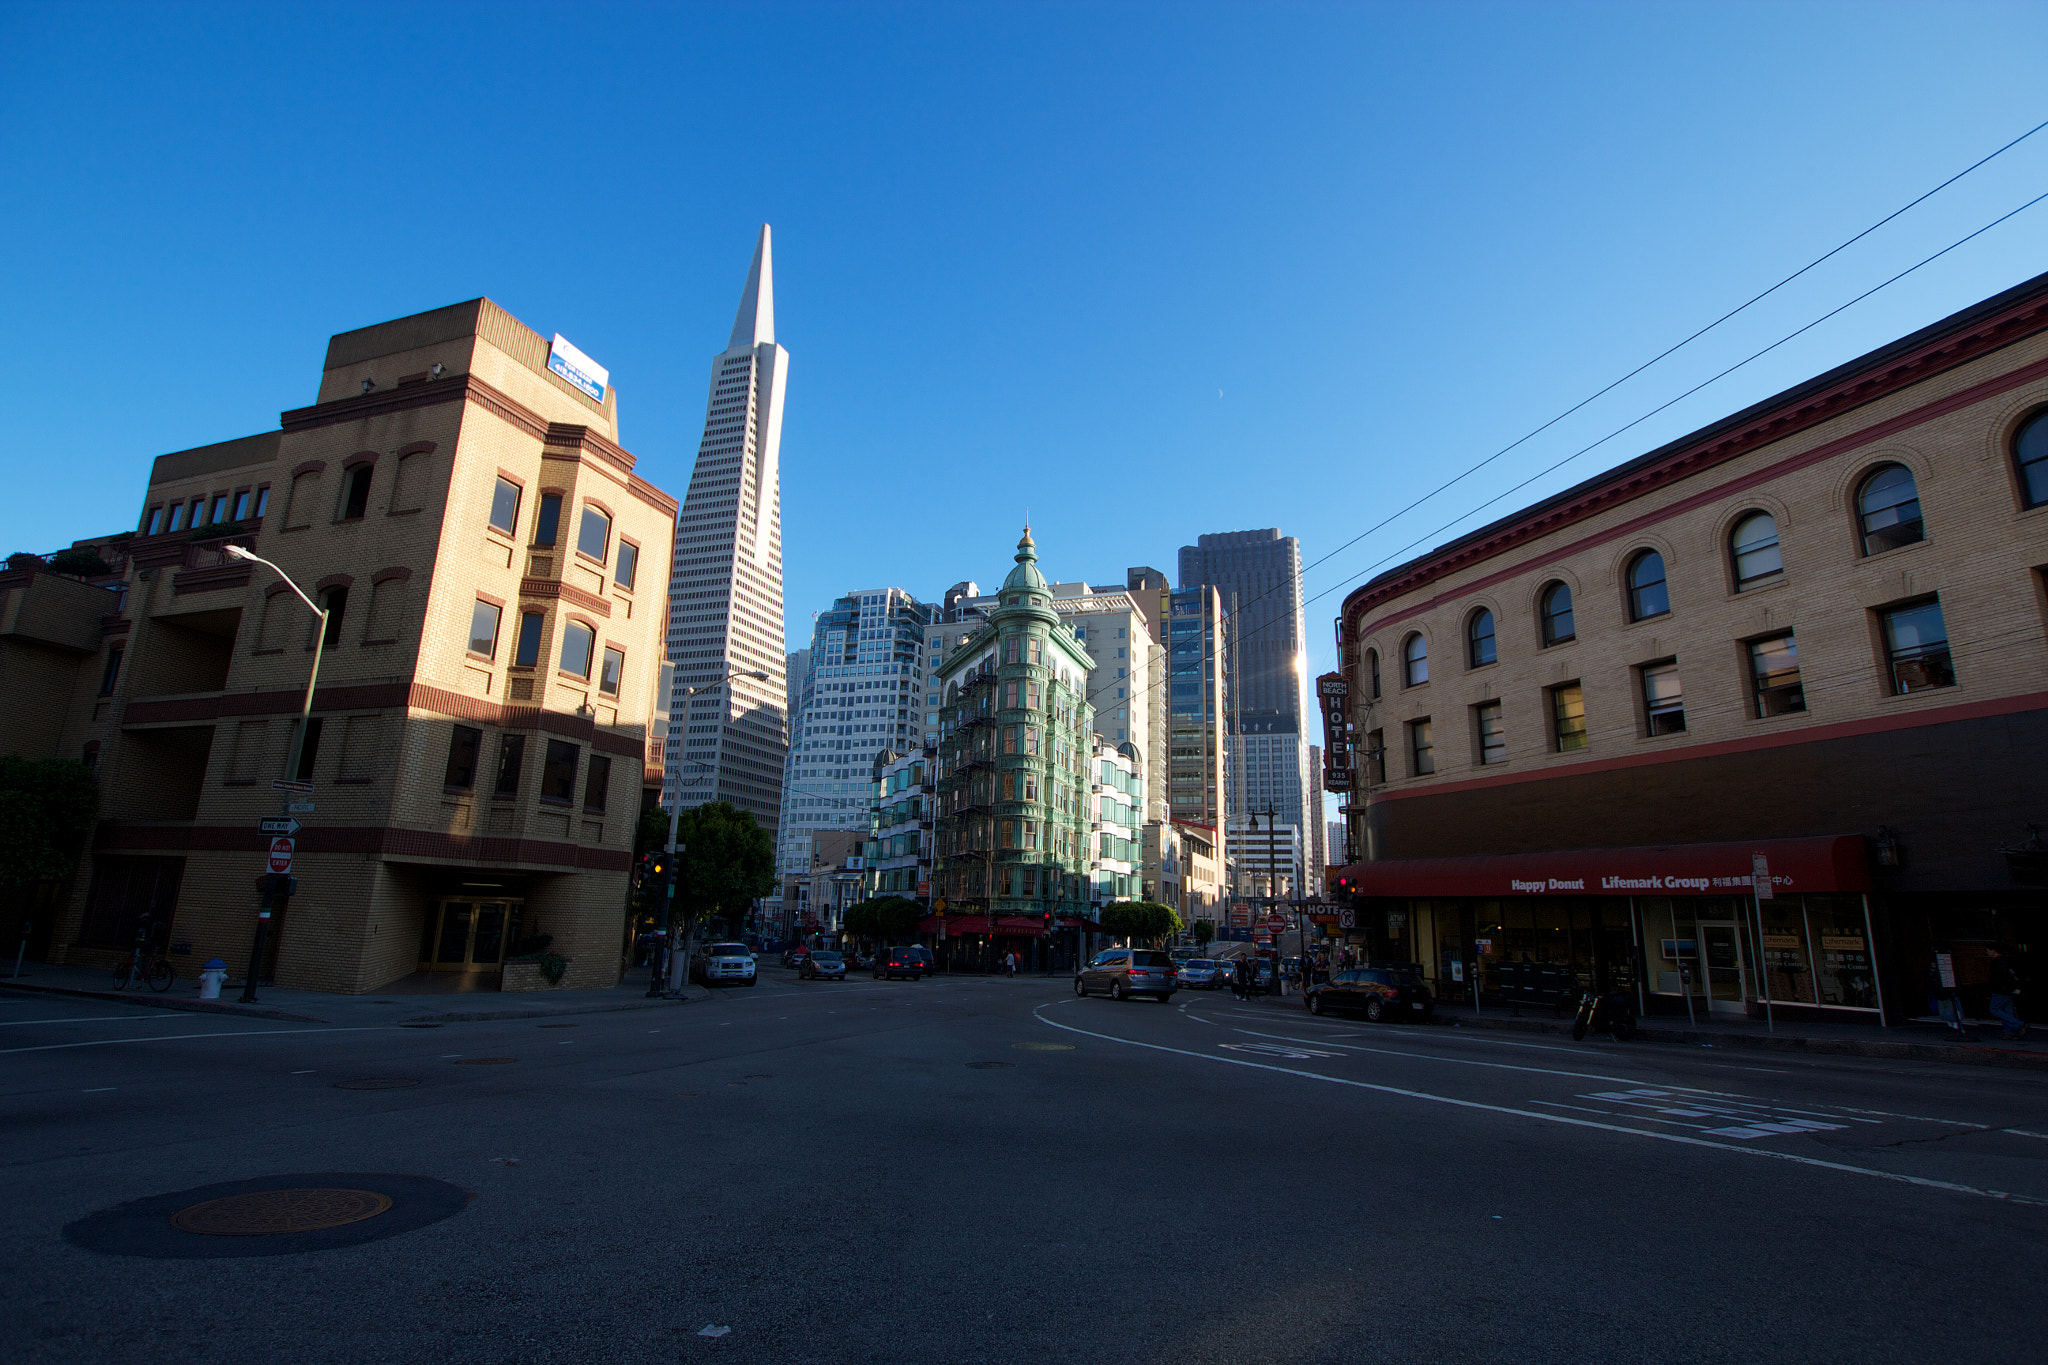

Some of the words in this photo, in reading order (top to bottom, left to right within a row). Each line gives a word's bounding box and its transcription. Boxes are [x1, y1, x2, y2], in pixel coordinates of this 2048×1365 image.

[1323, 681, 1347, 689] NORTH
[1330, 697, 1345, 769] HOTEL
[1328, 779, 1350, 787] KEARNY
[263, 822, 276, 830] ONE
[276, 822, 290, 830] WAY
[1511, 879, 1546, 893] Happy
[1548, 878, 1585, 890] Donut
[1601, 875, 1663, 889] Lifemark
[1664, 875, 1709, 891] Group
[1712, 875, 1794, 888] 利福集團中心
[1307, 904, 1339, 915] HOTE
